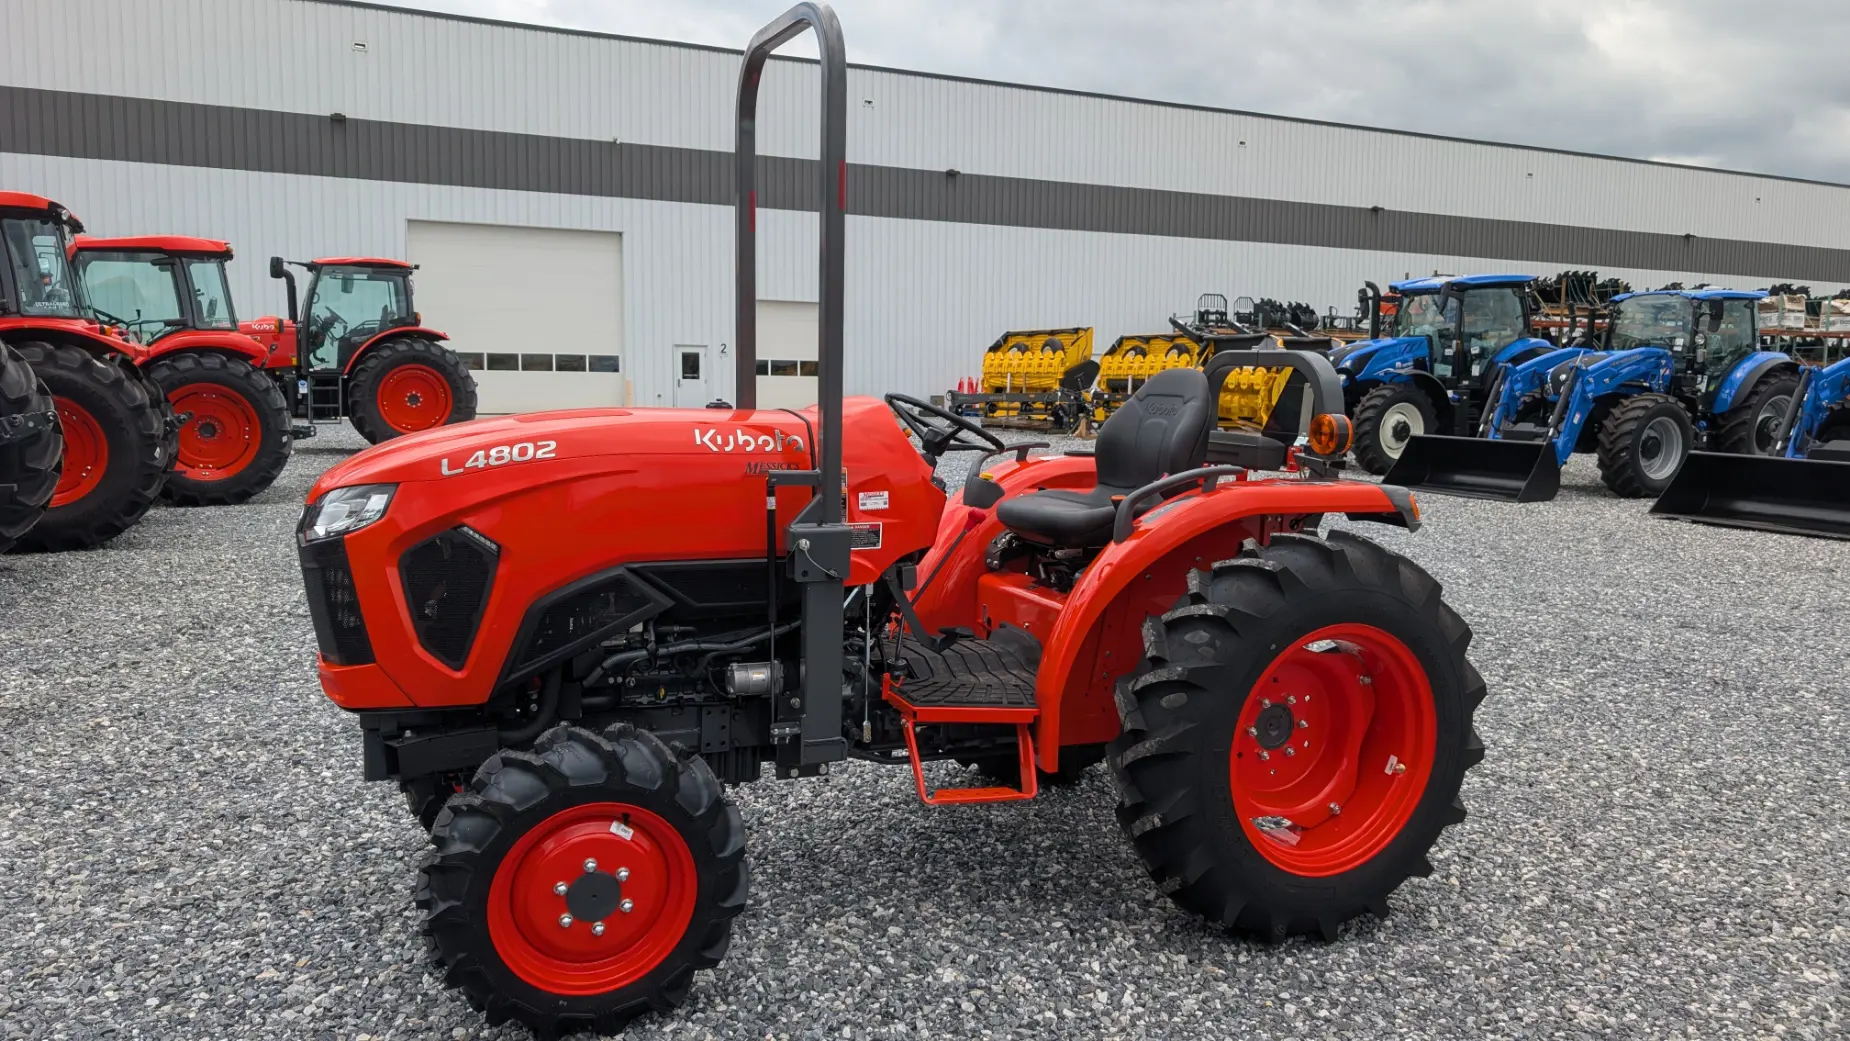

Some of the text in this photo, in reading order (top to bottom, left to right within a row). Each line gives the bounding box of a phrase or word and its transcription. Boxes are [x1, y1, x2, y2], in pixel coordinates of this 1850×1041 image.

[720, 343, 727, 354] 2
[694, 428, 804, 452] Kubota
[441, 440, 557, 476] L4802
